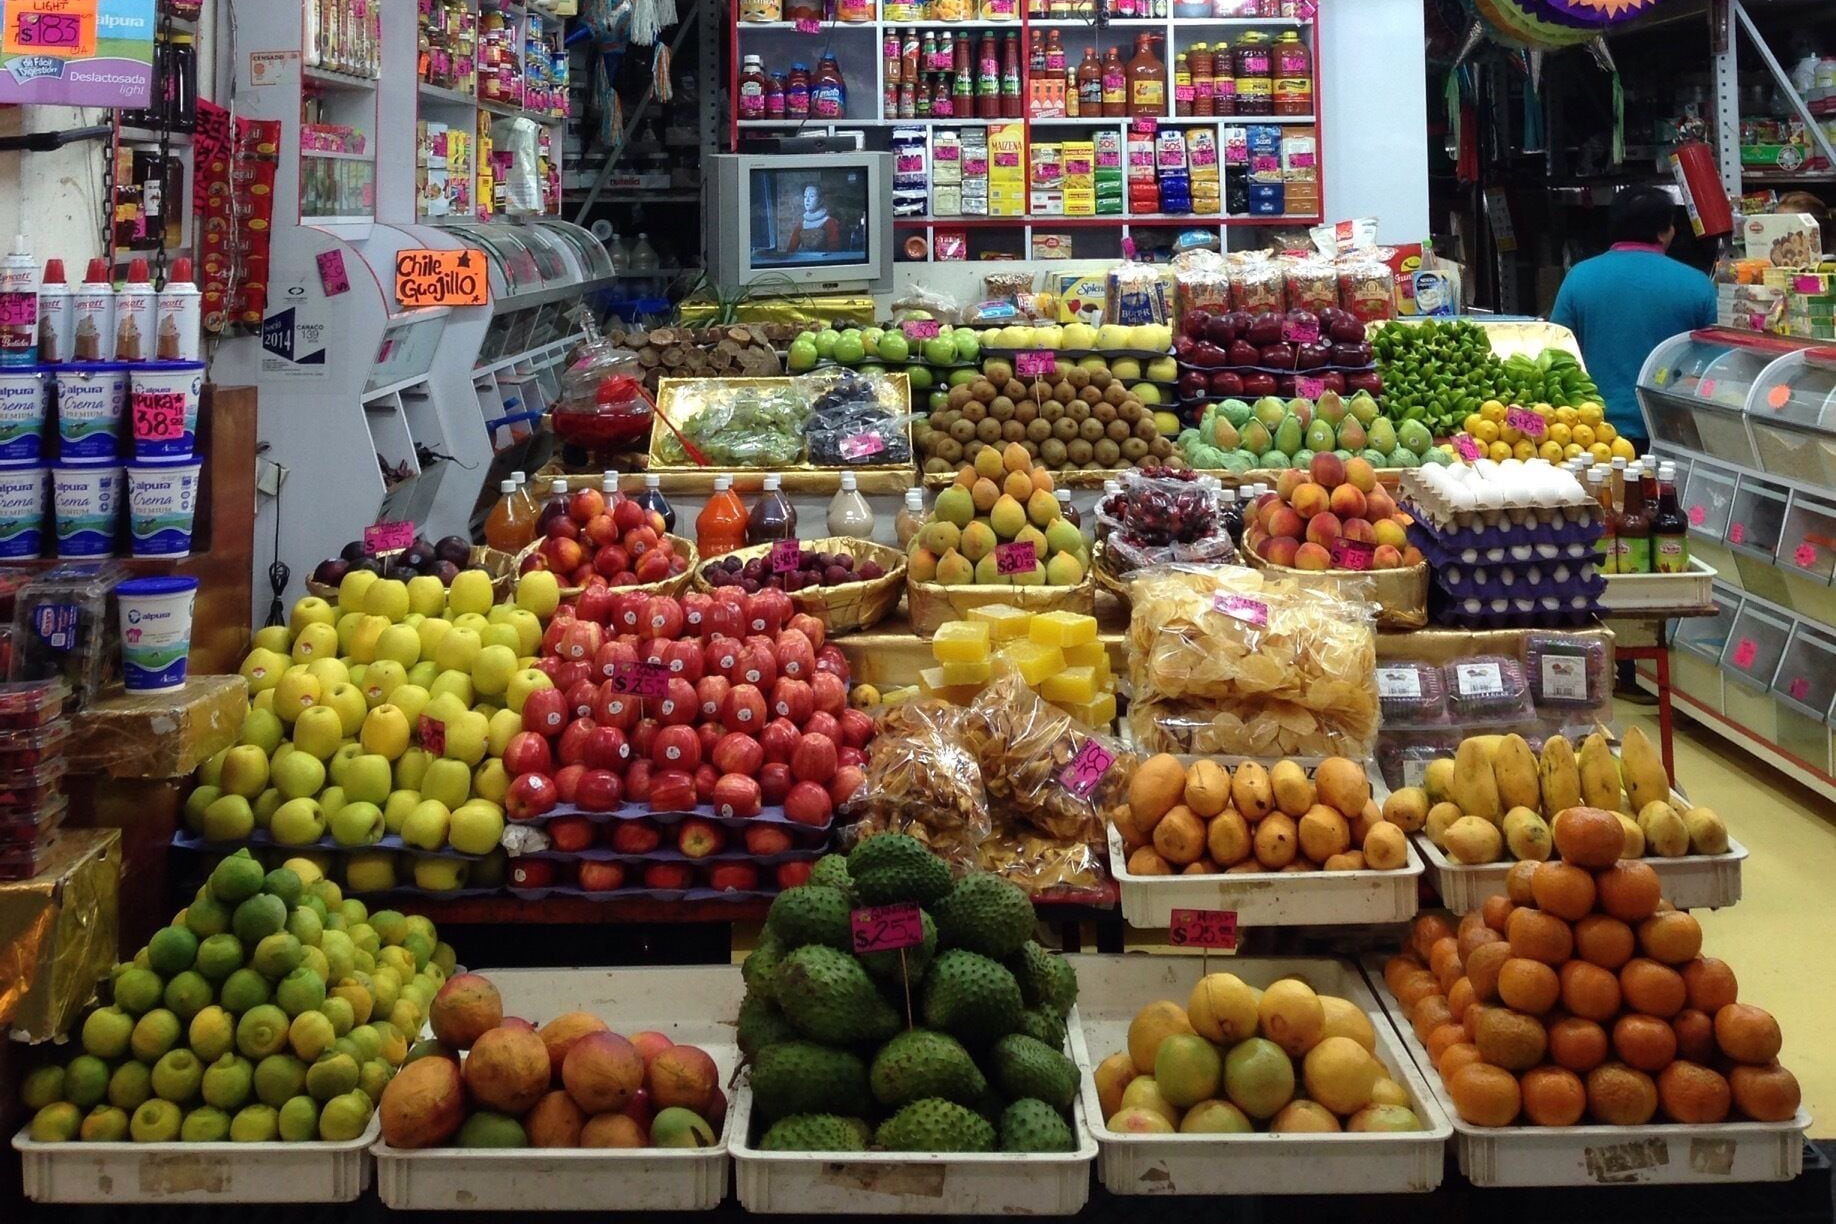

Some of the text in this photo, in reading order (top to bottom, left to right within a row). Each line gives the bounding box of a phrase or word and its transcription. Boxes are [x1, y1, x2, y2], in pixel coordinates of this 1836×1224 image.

[33, 1, 69, 11] LIGHT
[96, 15, 144, 28] alpura
[70, 71, 146, 84] Deslactosada
[119, 84, 144, 96] light
[811, 87, 840, 100] Clmato
[991, 141, 1022, 151] MAIZENA
[1099, 140, 1115, 148] SOS
[1164, 142, 1181, 150] SOS
[398, 255, 442, 277] Chile
[1076, 283, 1106, 296] Splen
[264, 329, 292, 352] 2014
[66, 386, 104, 396] alpura
[0, 396, 34, 411] rema
[64, 395, 105, 410] Crema
[55, 482, 89, 492] alpura
[136, 481, 172, 492] alpura
[0, 498, 34, 509] rema
[55, 493, 91, 507] Crema
[134, 491, 174, 506] Crema
[142, 611, 171, 621] alpura
